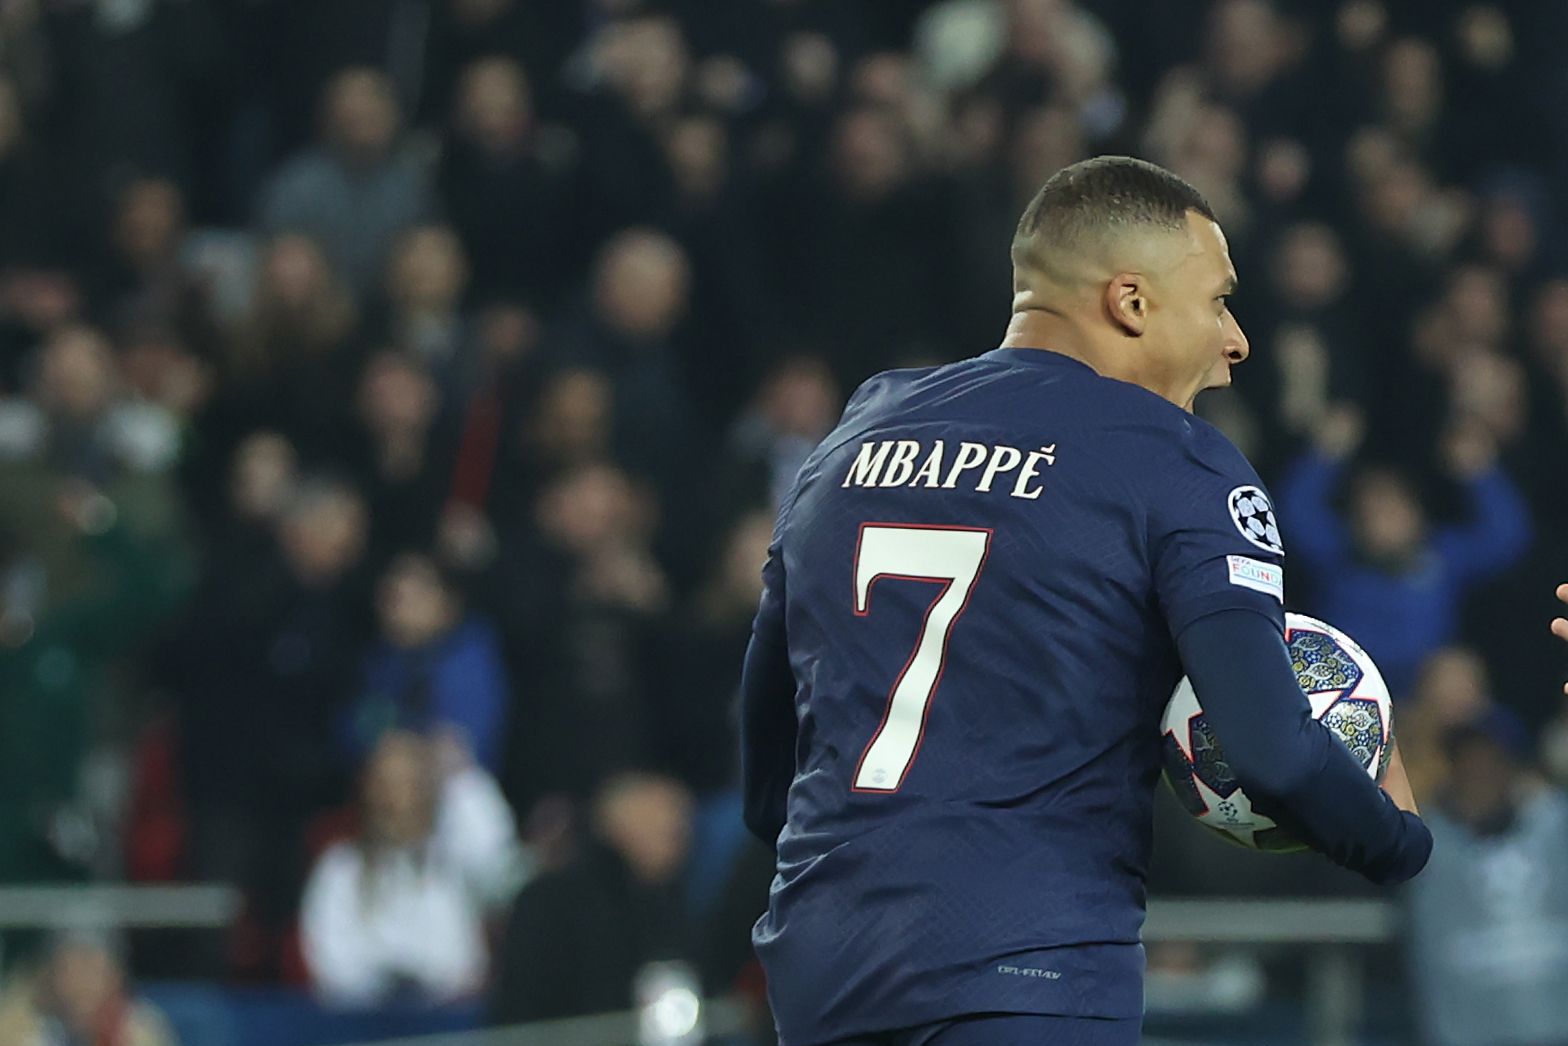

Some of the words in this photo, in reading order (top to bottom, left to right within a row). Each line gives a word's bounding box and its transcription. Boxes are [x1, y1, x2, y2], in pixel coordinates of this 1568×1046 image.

[841, 439, 1056, 500] MBAPPÉ
[1232, 564, 1281, 585] FOUND
[851, 521, 994, 792] 7
